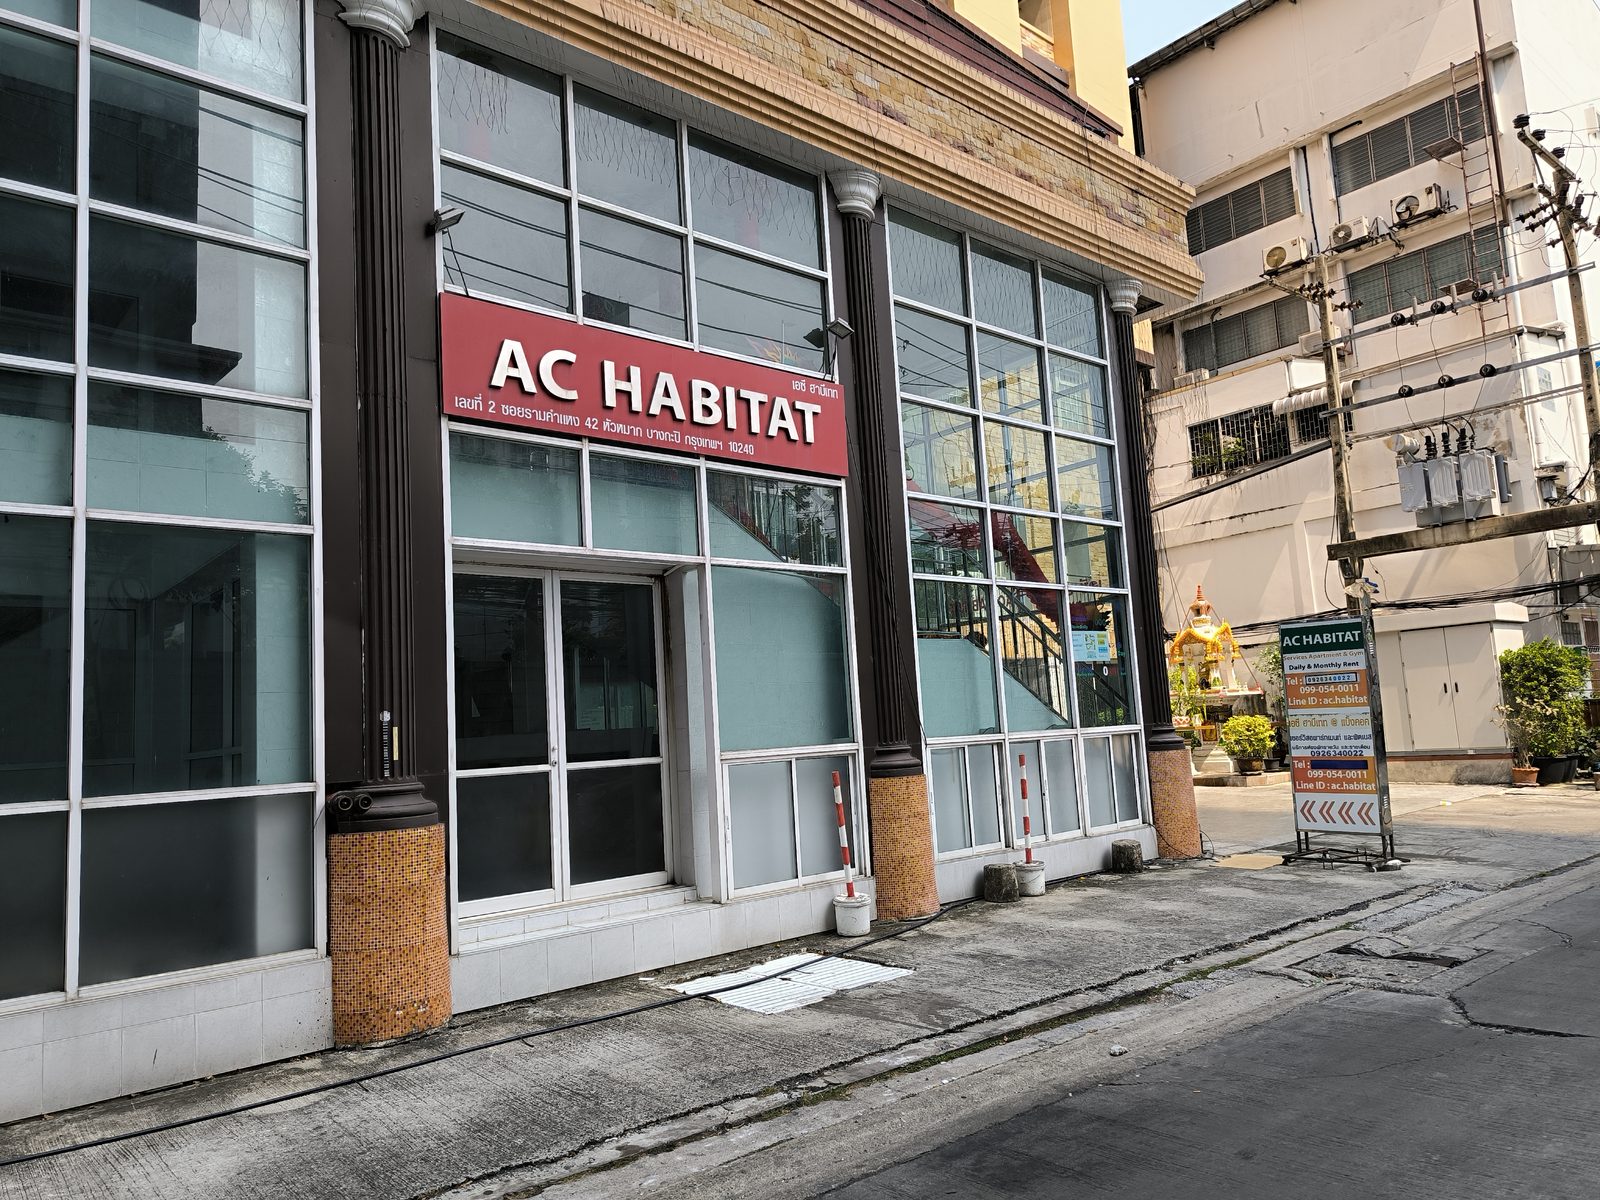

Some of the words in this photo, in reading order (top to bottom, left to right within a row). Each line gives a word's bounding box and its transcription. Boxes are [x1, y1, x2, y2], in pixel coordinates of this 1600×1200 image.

[792, 379, 806, 392] เอซี
[489, 338, 579, 401] AC
[601, 359, 822, 444] HABITAT
[455, 393, 482, 412] เลขที่
[488, 400, 496, 413] 2
[501, 403, 580, 427] ซอยรามคำแหง
[584, 416, 599, 430] 42
[603, 418, 643, 438] หัวหมาก
[646, 428, 681, 443] บางกะปิ
[685, 435, 723, 451] กรุงเทพฯ
[728, 441, 754, 455] 10240
[1283, 635, 1301, 647] AC
[1302, 630, 1361, 645] HABITAT
[1309, 652, 1342, 660] Apartment
[1349, 650, 1364, 658] Gym
[1289, 663, 1306, 671] Daily
[1300, 684, 1359, 694] 099-054-0011
[1288, 698, 1306, 706] Line
[1308, 697, 1318, 705] ID
[1323, 695, 1368, 704] ac.habitat
[1307, 770, 1367, 779] 099-054-0011
[1296, 781, 1314, 789] Line
[1315, 781, 1325, 789] ID
[1331, 781, 1376, 791] ac.habitat
